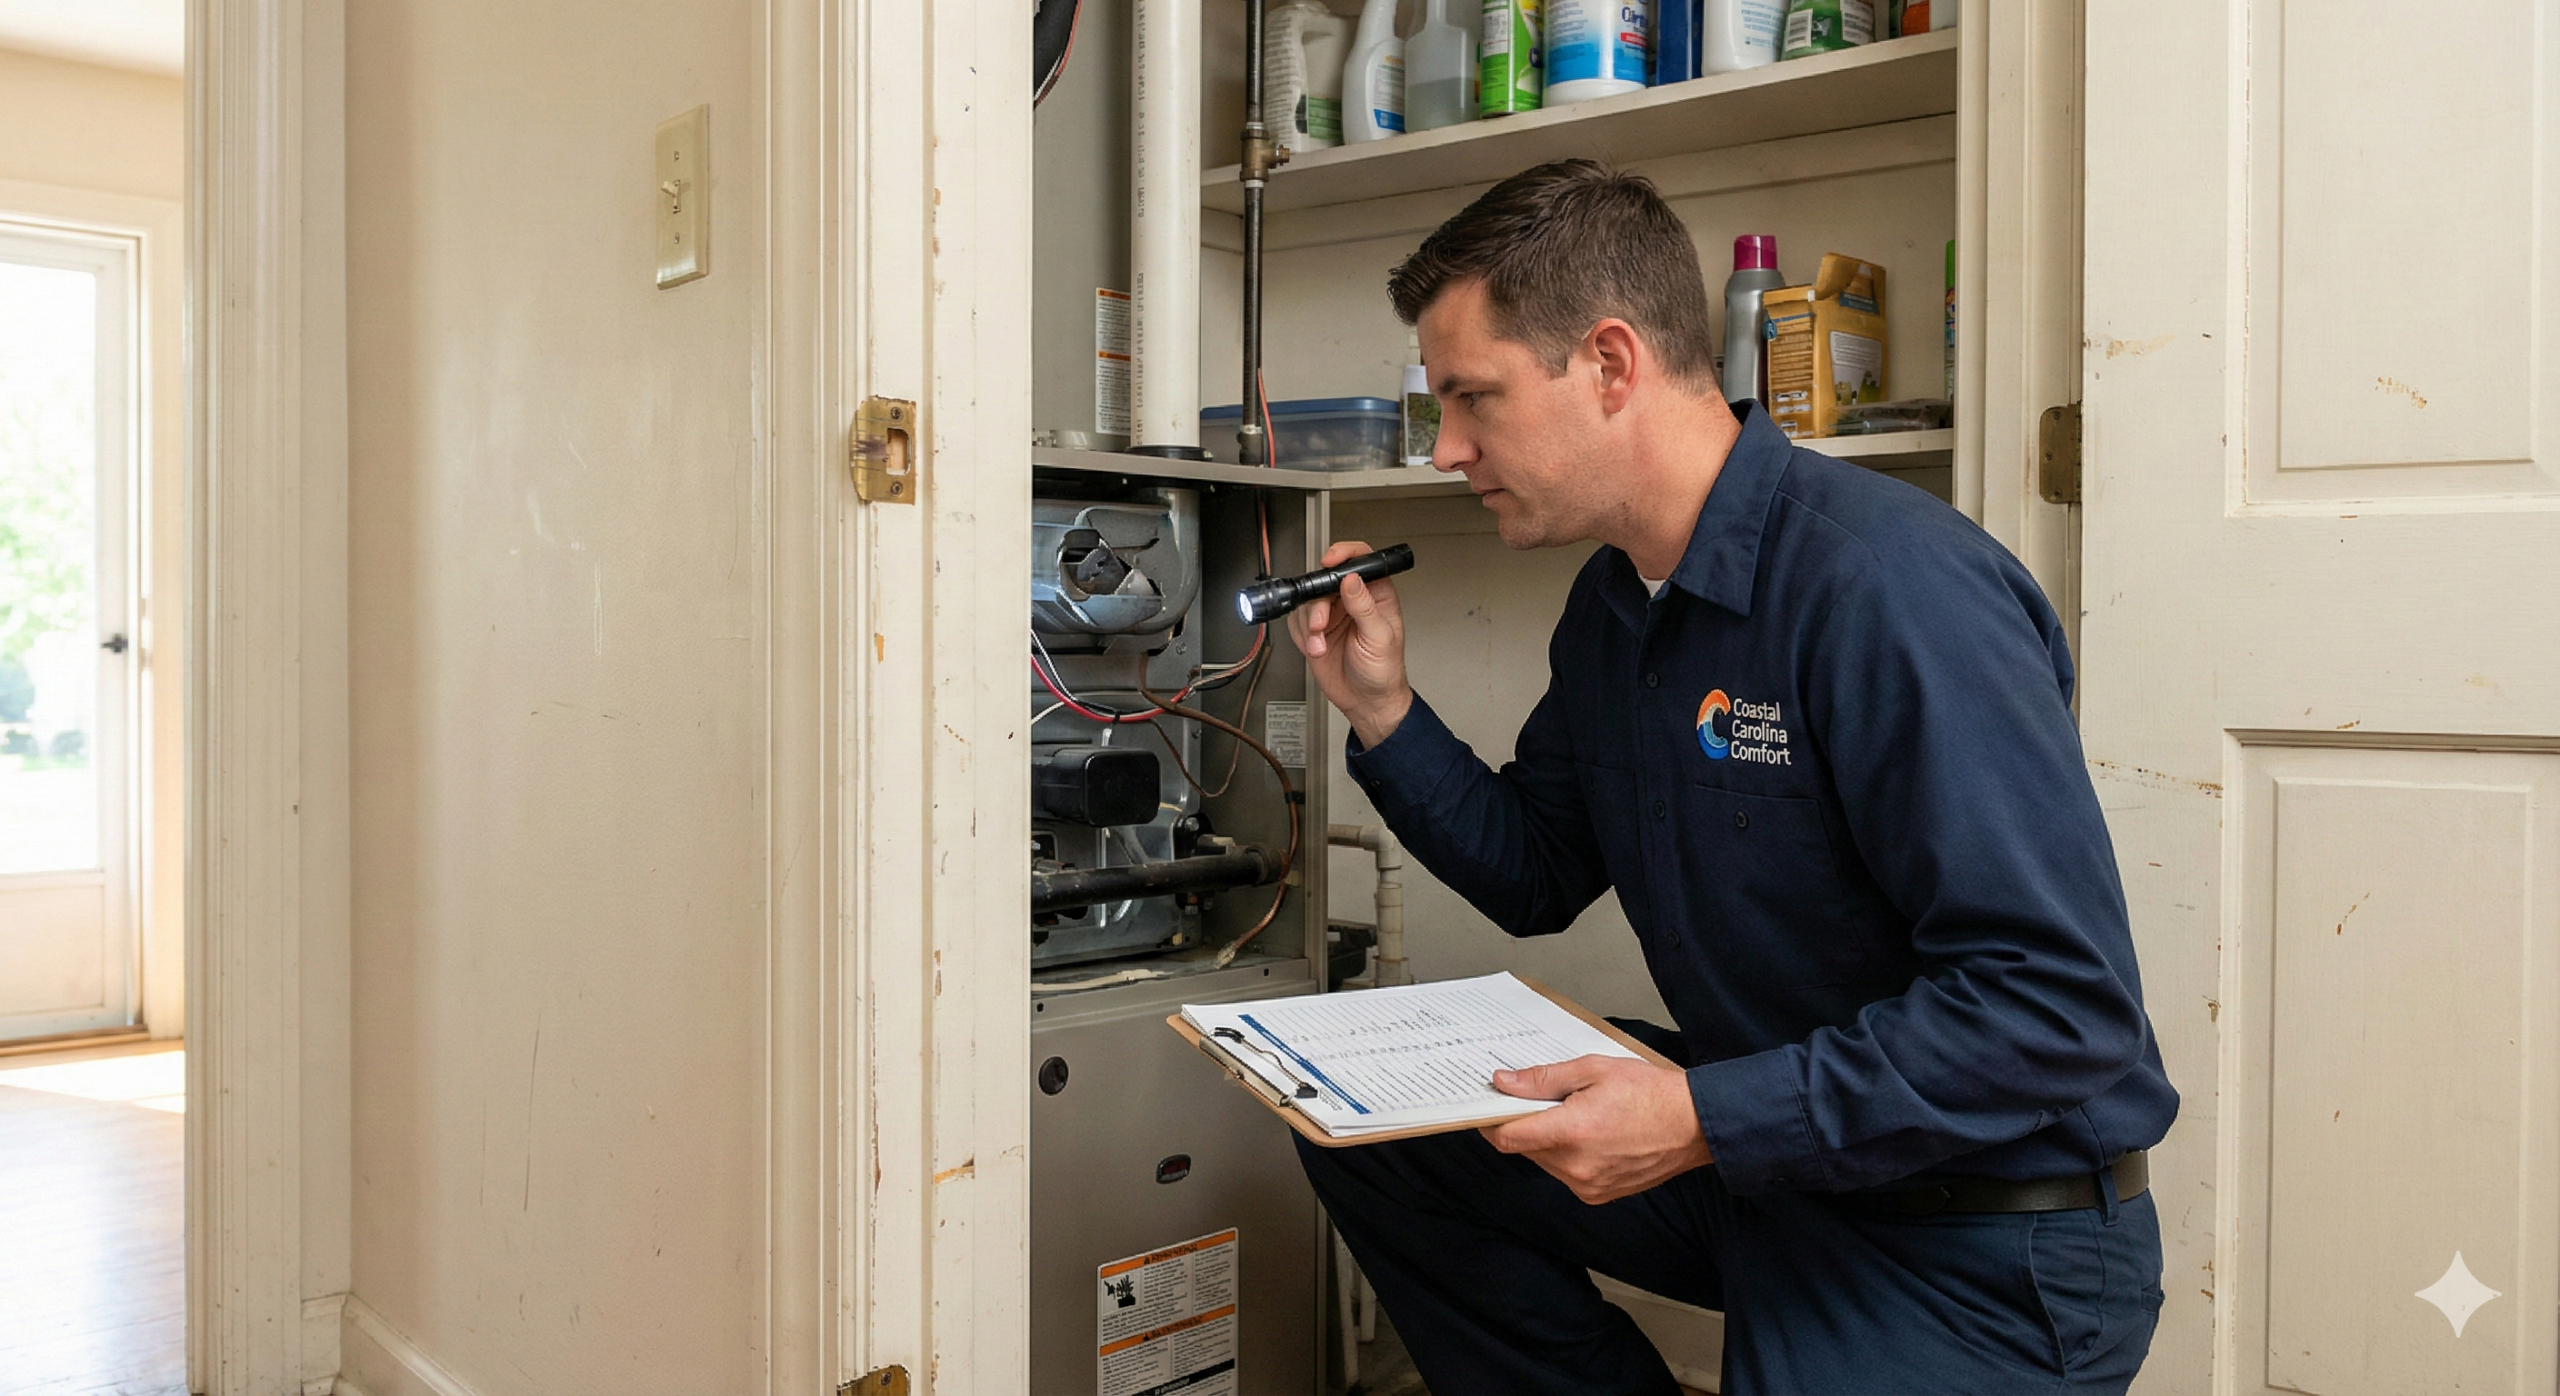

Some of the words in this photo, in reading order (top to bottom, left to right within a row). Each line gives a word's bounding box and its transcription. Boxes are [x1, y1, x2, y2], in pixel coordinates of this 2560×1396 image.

[1733, 698, 1780, 722] Coastal
[1732, 719, 1788, 744] Carolina
[1731, 740, 1792, 766] Comfort
